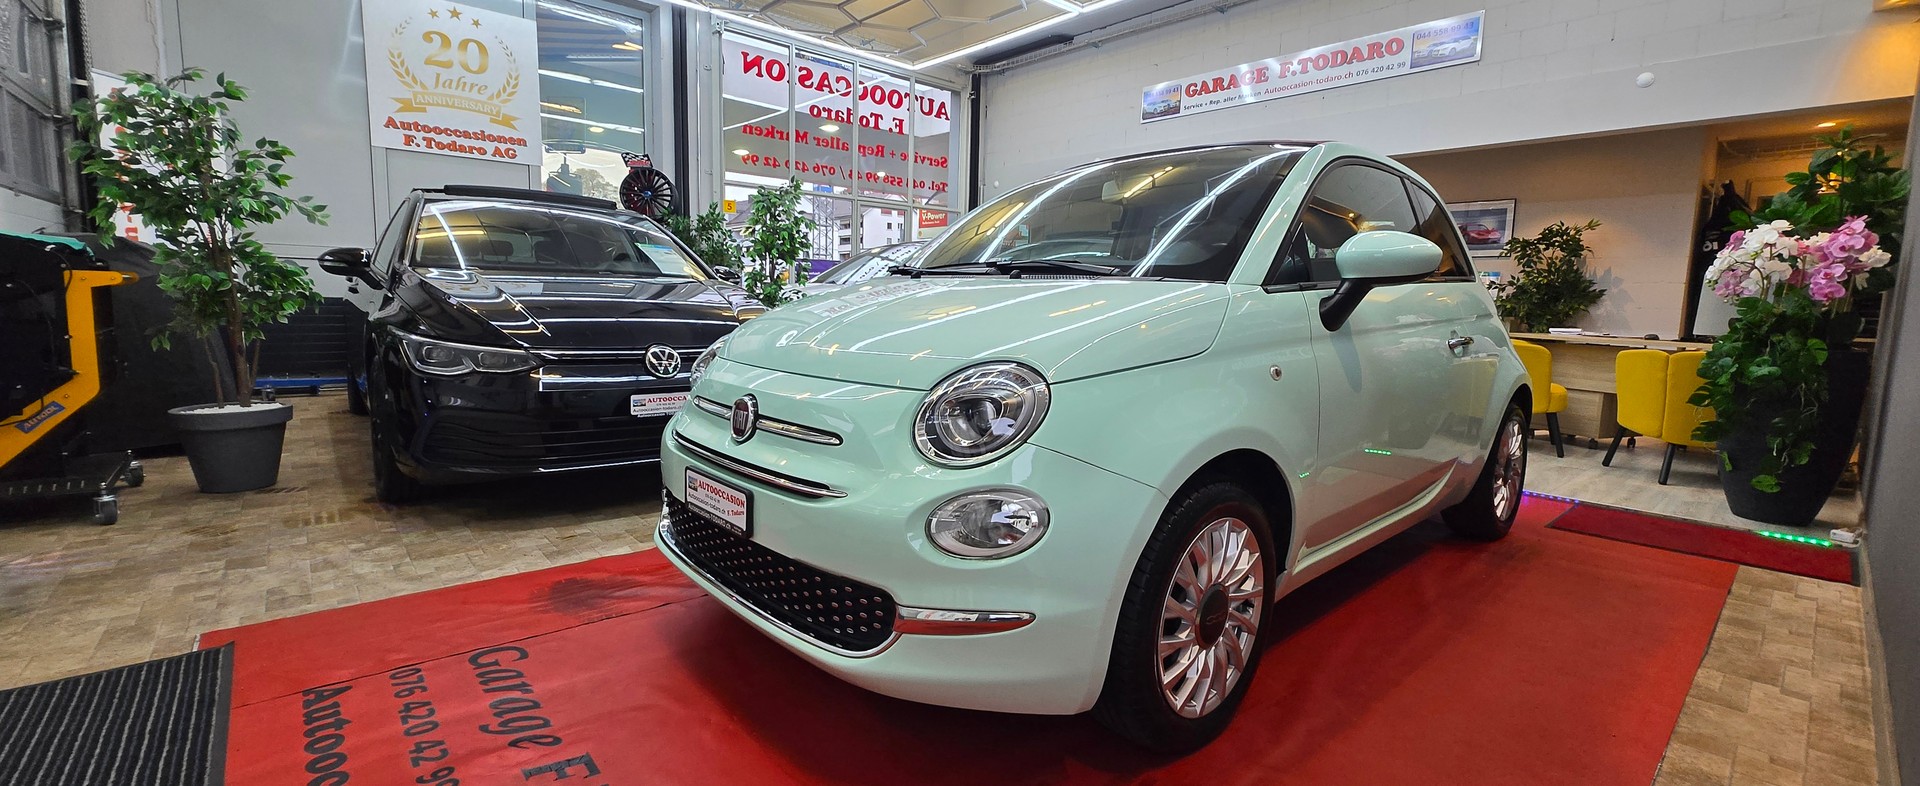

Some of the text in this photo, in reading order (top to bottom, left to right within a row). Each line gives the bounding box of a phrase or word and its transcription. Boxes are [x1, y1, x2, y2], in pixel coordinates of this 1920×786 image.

[1416, 31, 1432, 40] 044
[421, 30, 489, 75] 20
[433, 72, 489, 96] Jahre
[1183, 102, 1204, 111] Service
[1356, 69, 1369, 77] 076
[1370, 65, 1384, 74] 420
[1396, 61, 1406, 69] 99
[1184, 66, 1270, 98] GARAGE
[415, 94, 499, 116] ANNIVERSARY
[383, 116, 528, 147] Autooccasionen
[402, 133, 518, 160] F. Todaro AG
[726, 202, 732, 211] 5
[921, 212, 946, 221] V-Power
[698, 480, 745, 508] AUTOOCCASION
[389, 667, 428, 699] 076
[398, 700, 440, 737] 420
[468, 646, 601, 781] Garage F
[409, 739, 449, 768] 42
